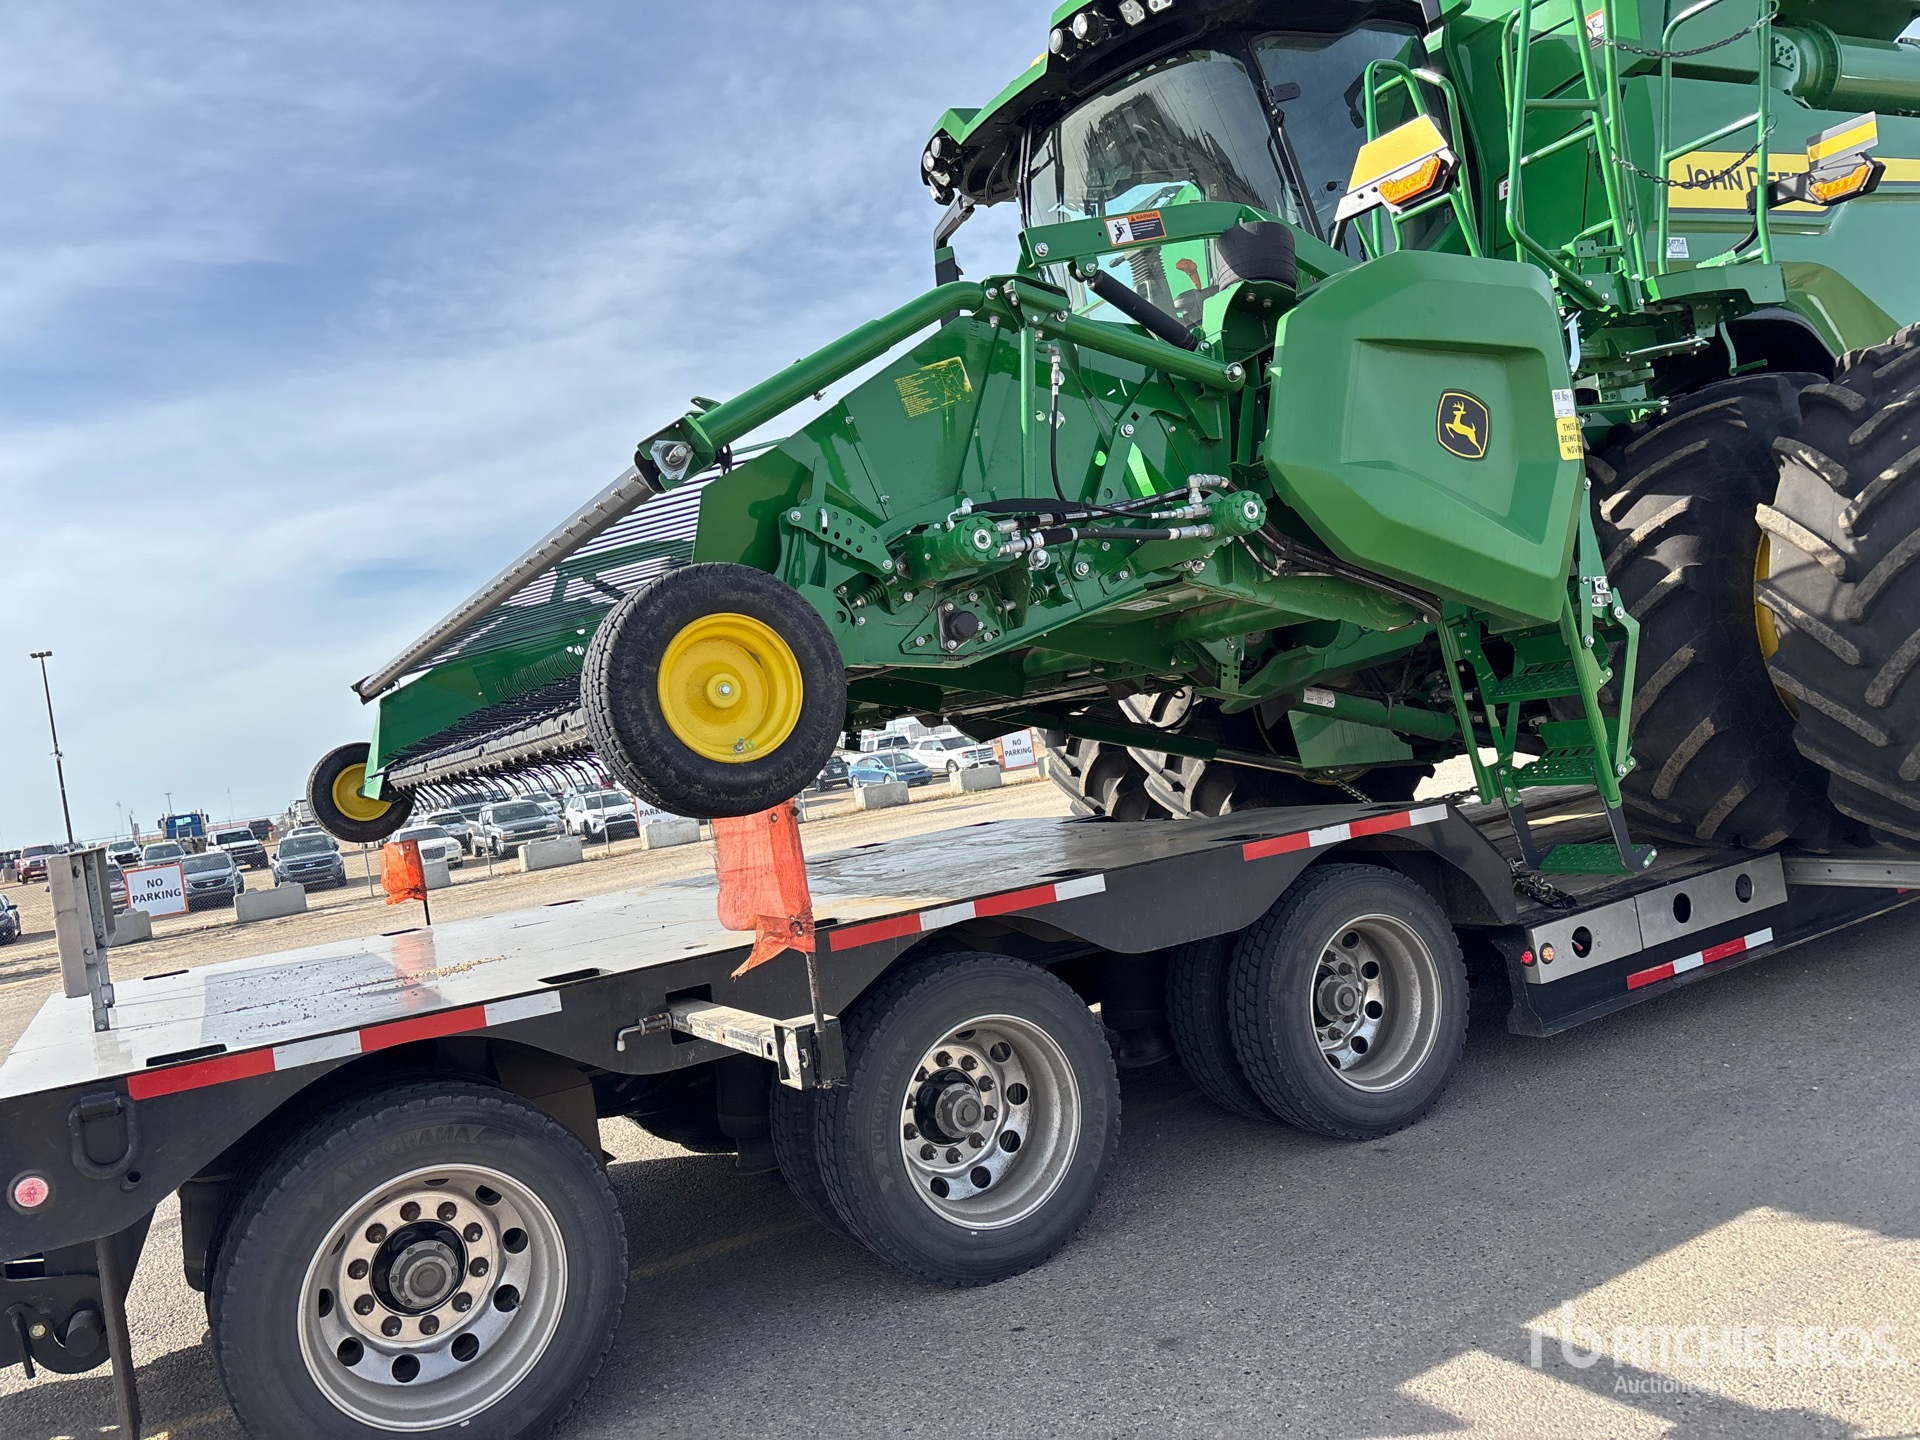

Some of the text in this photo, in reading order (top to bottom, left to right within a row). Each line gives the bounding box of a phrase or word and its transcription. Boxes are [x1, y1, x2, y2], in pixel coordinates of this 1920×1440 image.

[1686, 164, 1745, 191] JOHN
[1012, 738, 1022, 747] NO
[1004, 746, 1033, 757] PARKING
[146, 878, 163, 888] NO
[131, 887, 182, 904] PARKING
